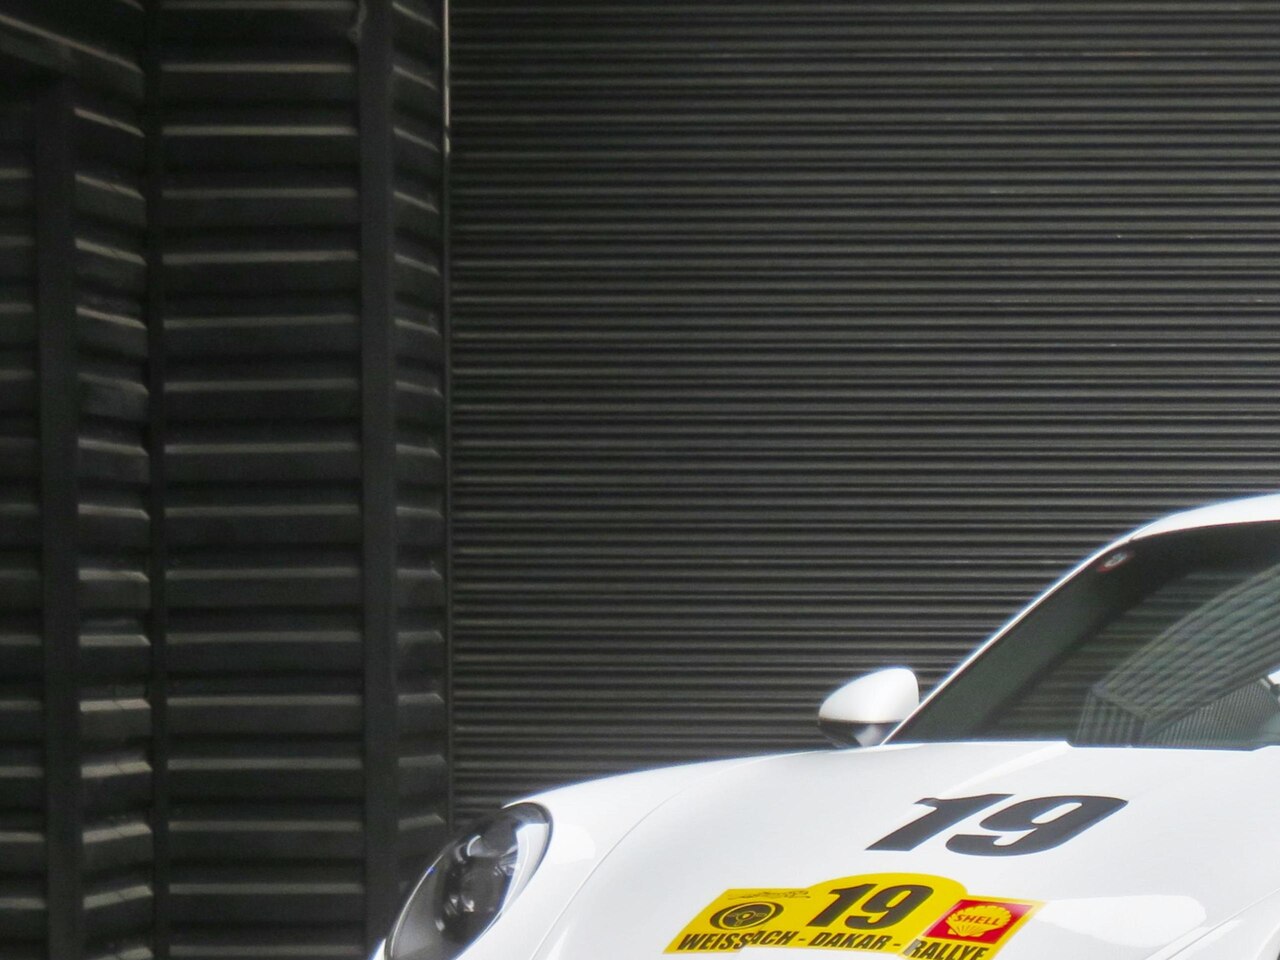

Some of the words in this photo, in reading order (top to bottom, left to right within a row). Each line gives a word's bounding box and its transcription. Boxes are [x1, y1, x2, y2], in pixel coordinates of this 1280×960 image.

[865, 793, 1129, 857] 19
[806, 883, 934, 930] 19
[954, 913, 1001, 927] SHELL
[677, 930, 800, 951] WEISSACH
[808, 932, 893, 950] DAKAR
